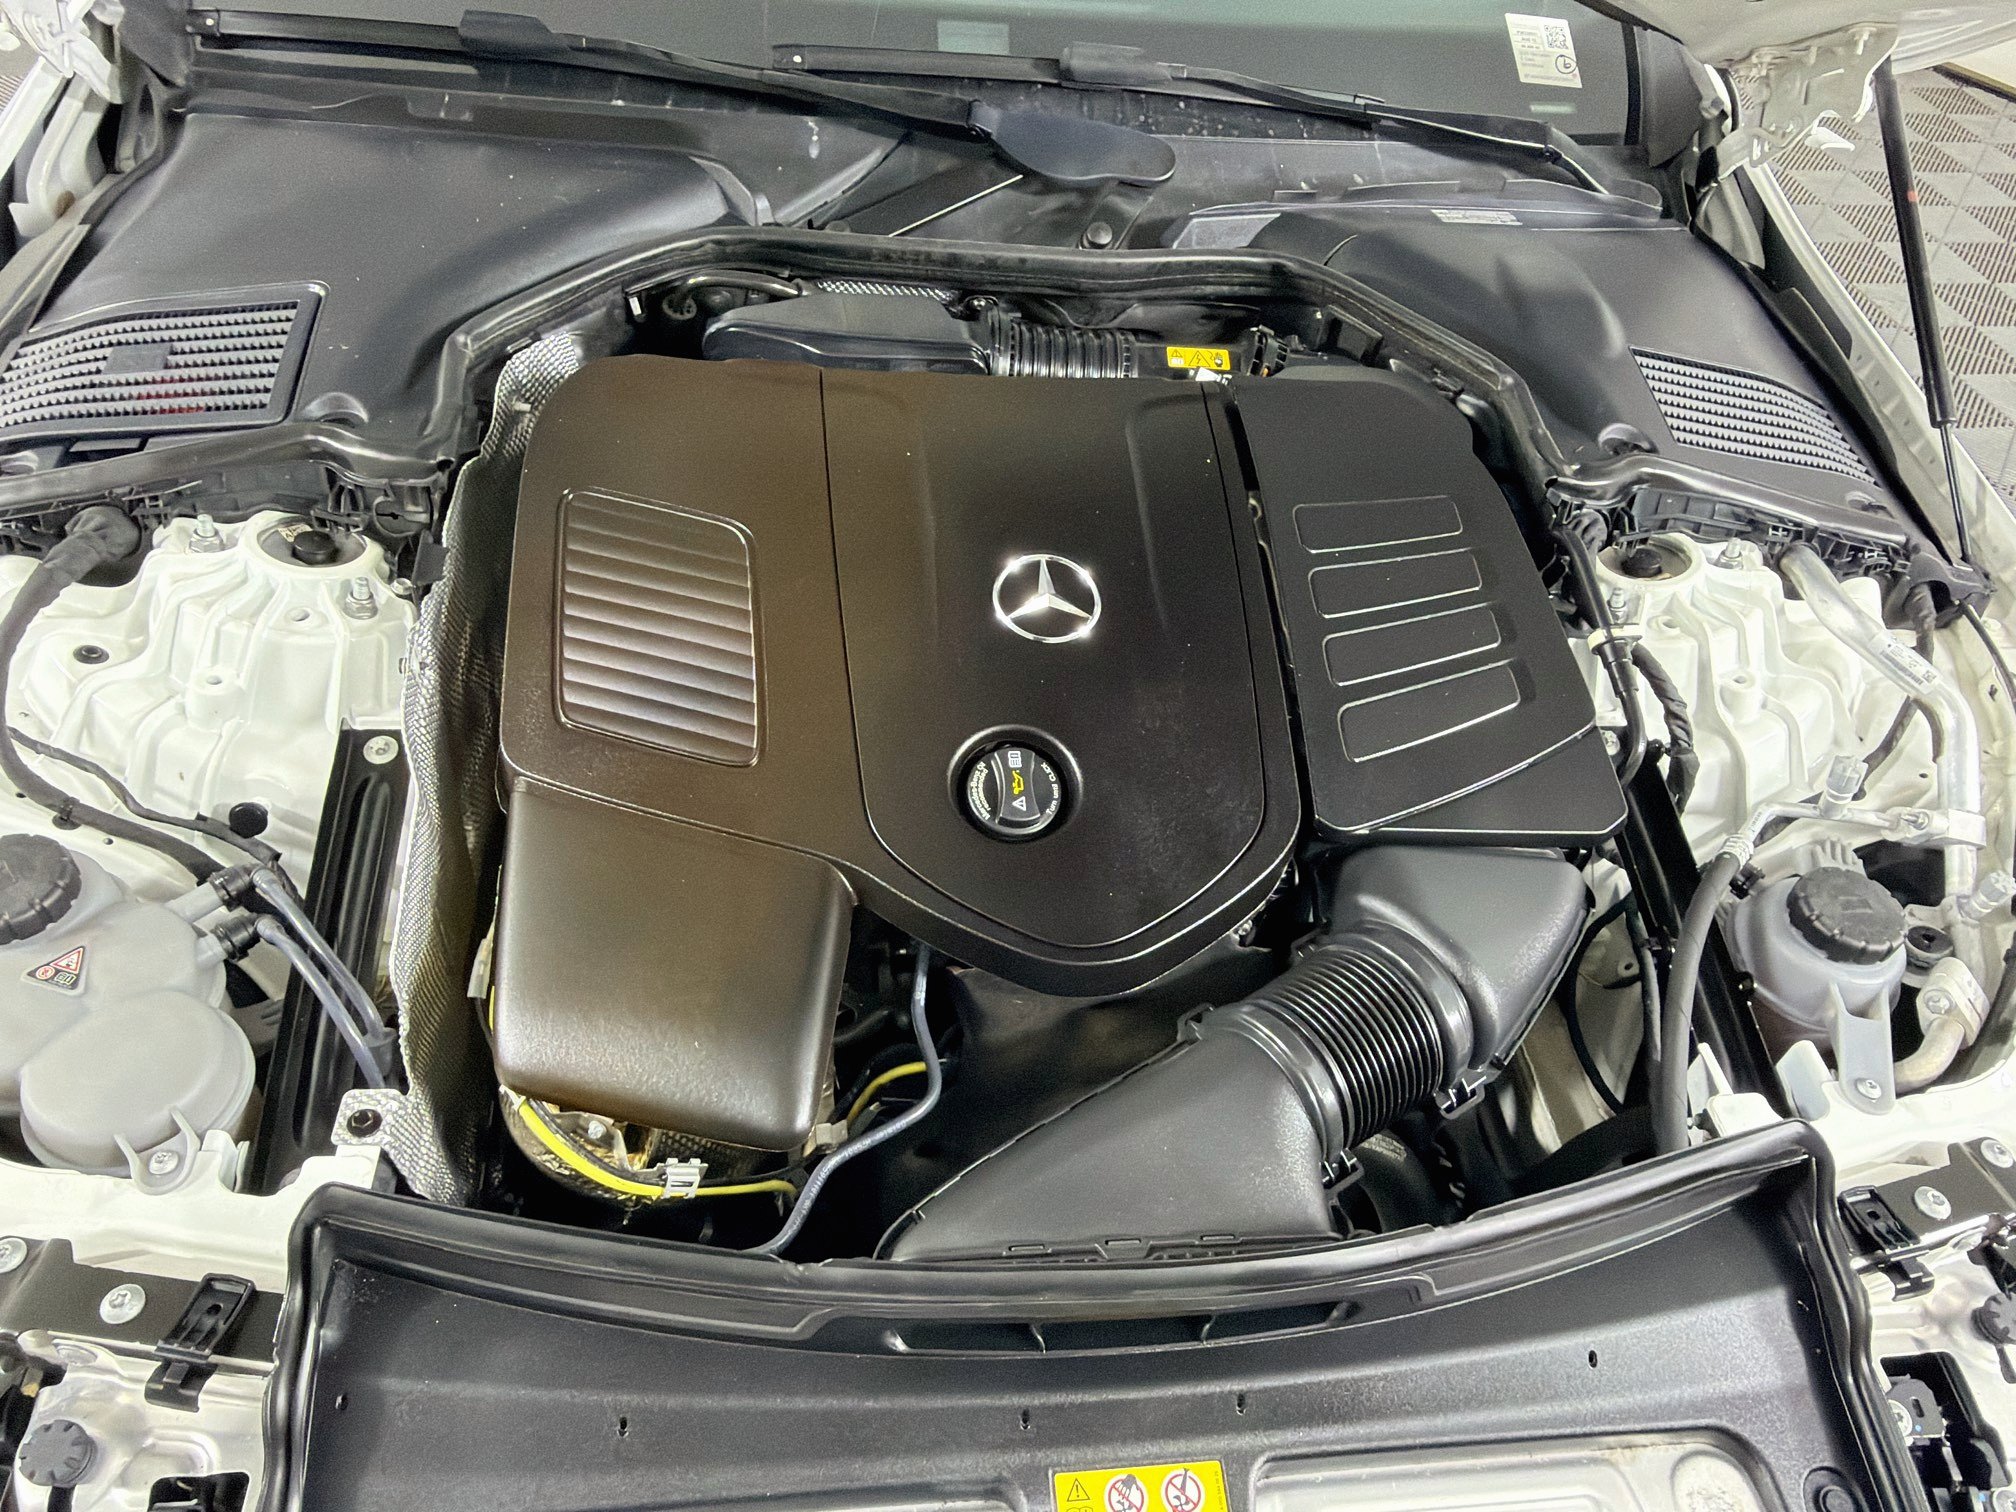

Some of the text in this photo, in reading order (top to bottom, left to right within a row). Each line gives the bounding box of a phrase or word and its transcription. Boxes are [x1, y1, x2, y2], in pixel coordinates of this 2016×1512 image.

[1041, 761, 1056, 781] CLICK
[970, 771, 991, 820] Mercedes-Benz
[978, 767, 991, 811] recommended
[1046, 800, 1057, 815] Turn
